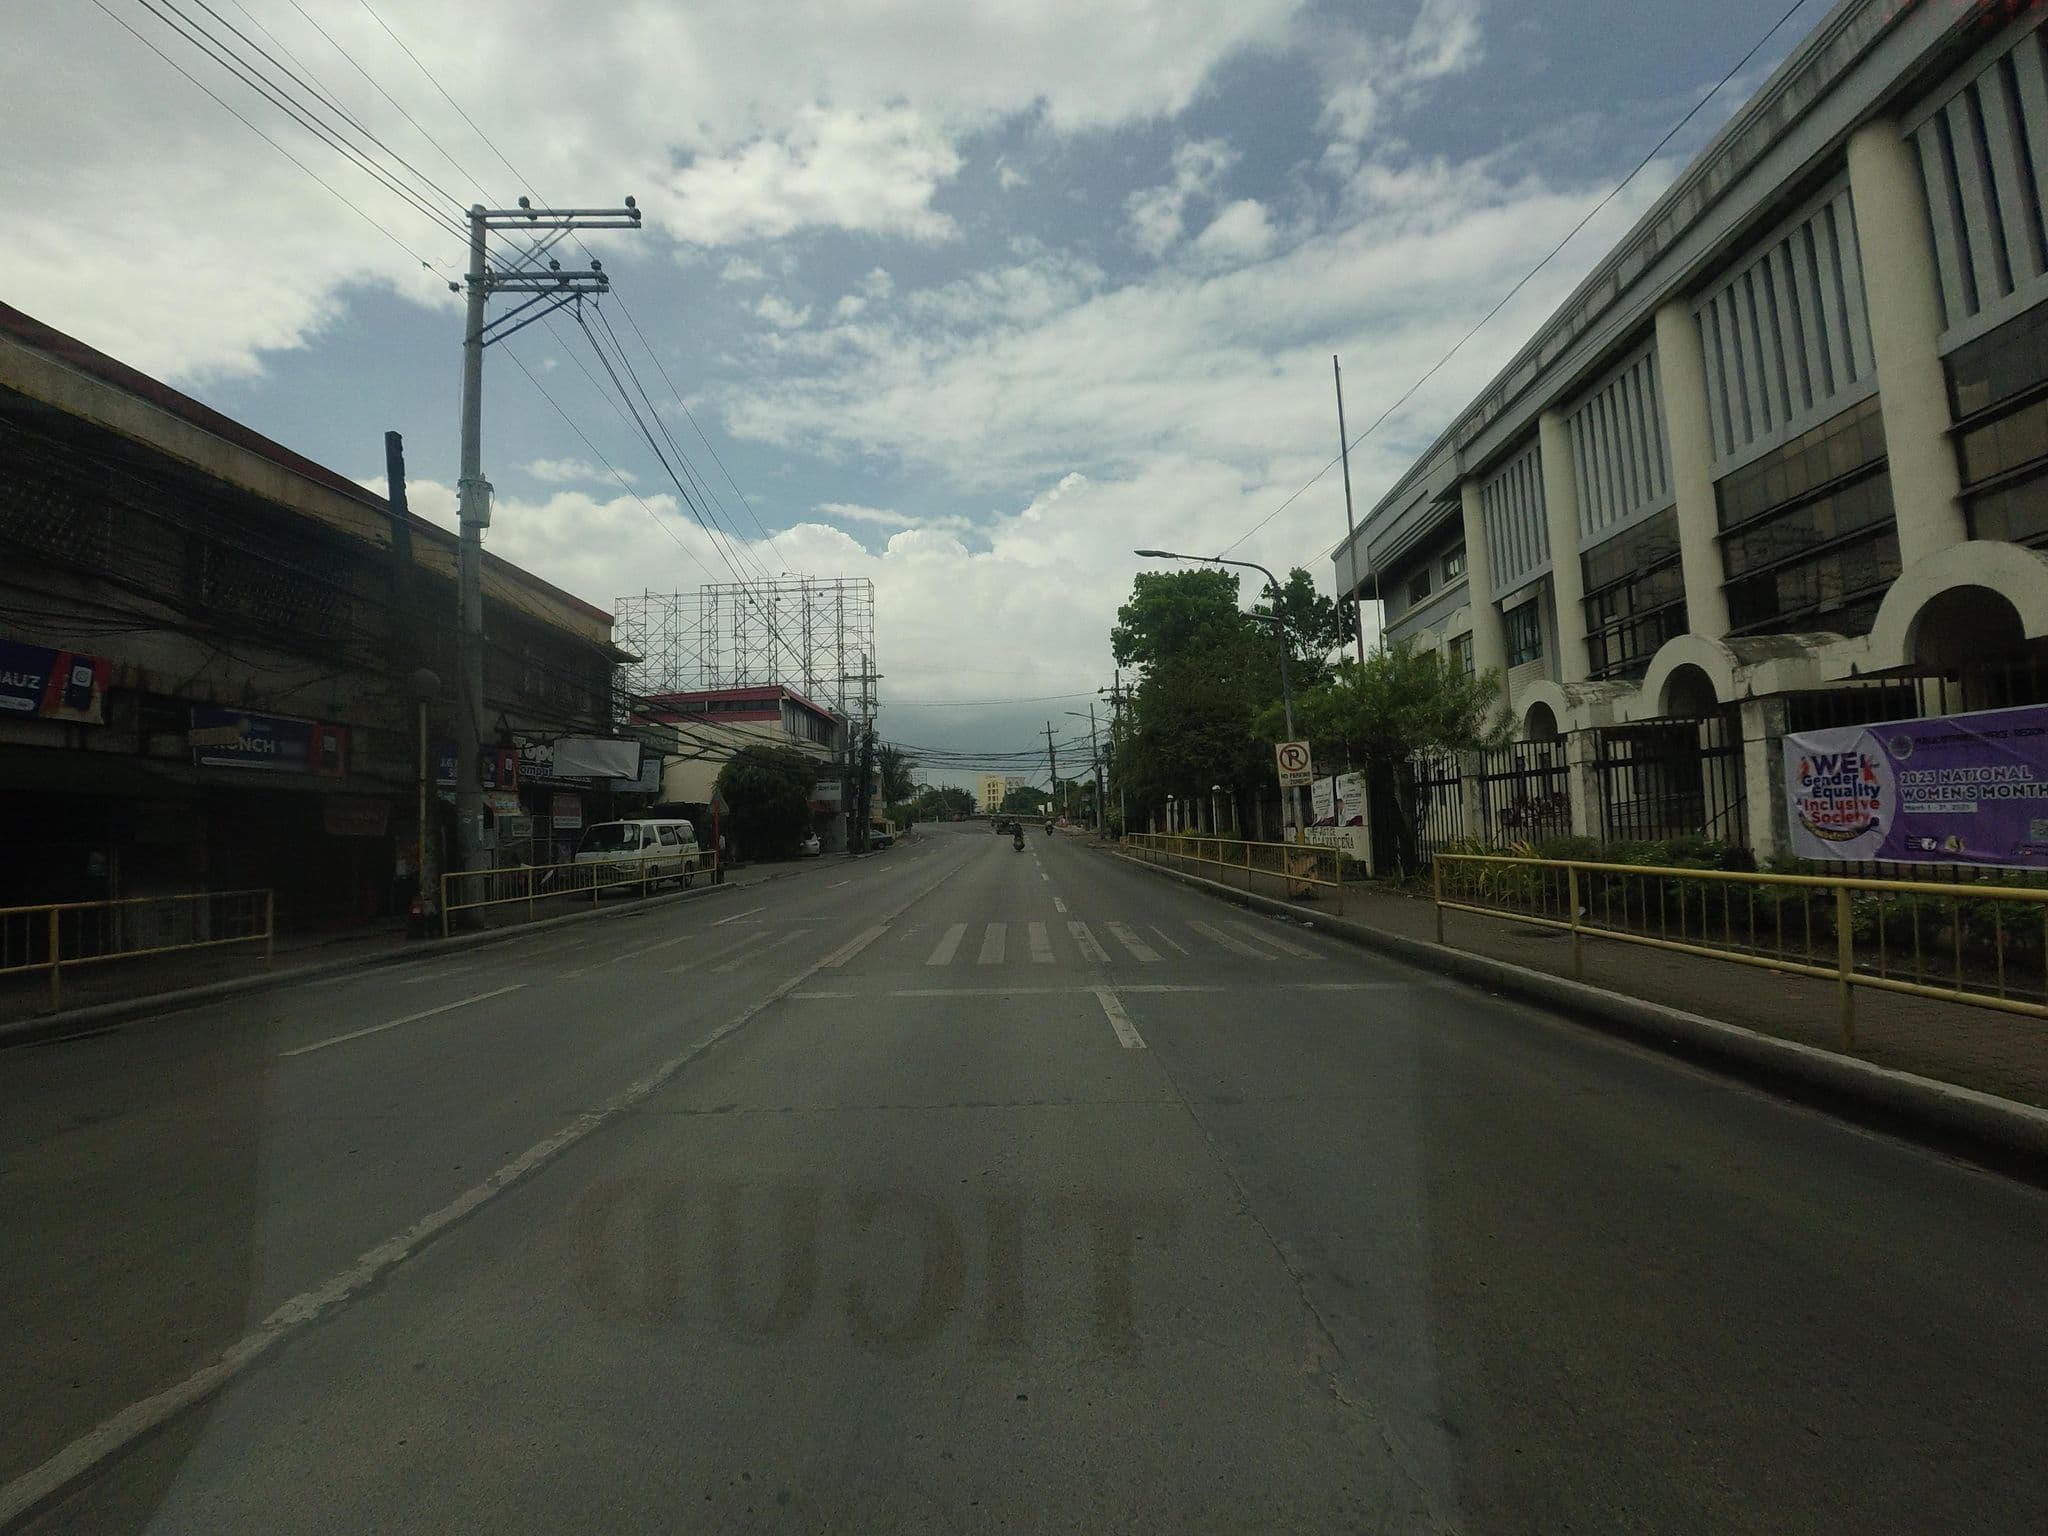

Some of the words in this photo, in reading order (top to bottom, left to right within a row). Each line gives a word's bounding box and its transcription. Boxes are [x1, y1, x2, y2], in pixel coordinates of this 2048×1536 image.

[0, 671, 41, 690] AUZ
[1803, 772, 1859, 787] Gender
[1901, 771, 1935, 785] 2023
[1939, 766, 2033, 783] NATIONAL
[1812, 782, 1880, 799] Equality
[1901, 784, 1977, 801] WOMEN'S
[1981, 783, 2048, 800] MONTH
[1805, 799, 1880, 811] Inclusive
[1811, 810, 1869, 824] Society
